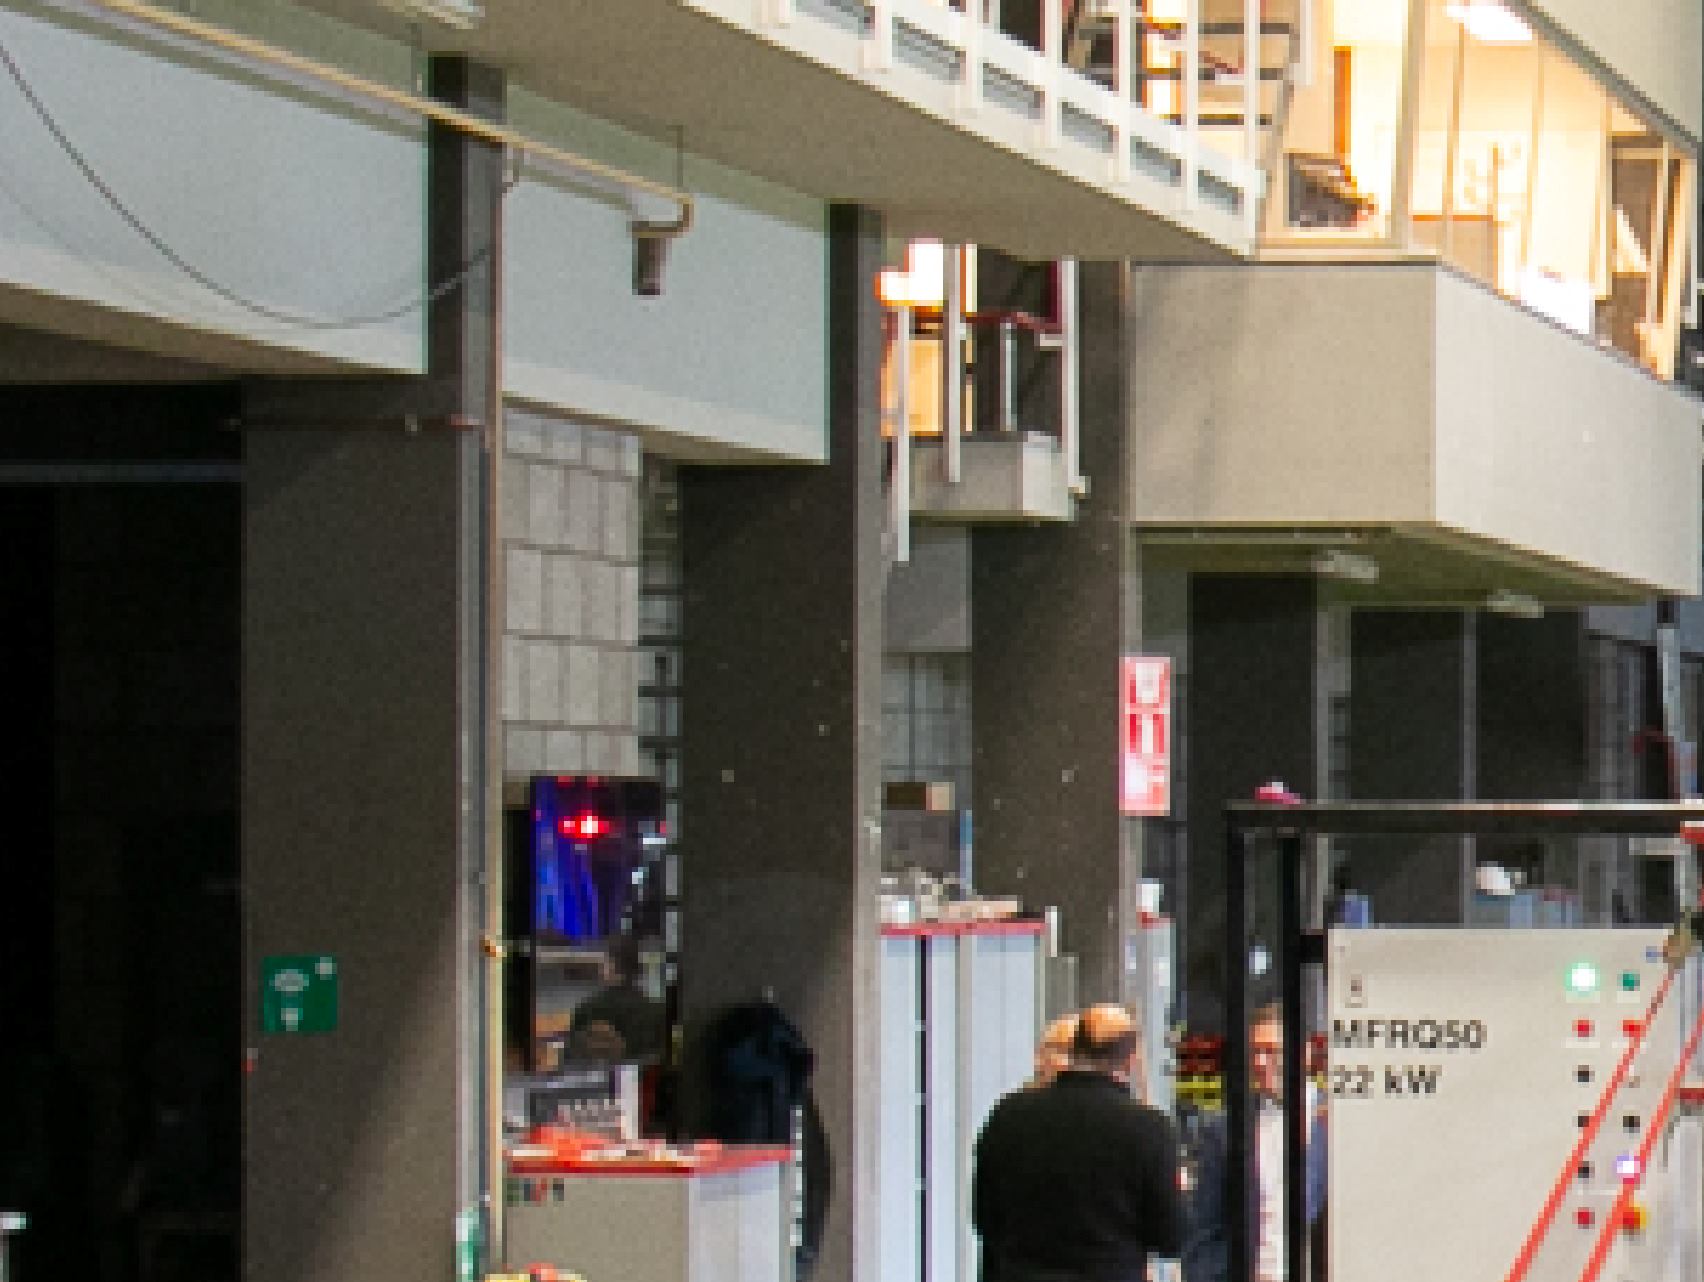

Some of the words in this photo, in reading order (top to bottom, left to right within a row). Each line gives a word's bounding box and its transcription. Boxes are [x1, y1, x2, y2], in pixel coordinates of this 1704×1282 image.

[1332, 1018, 1488, 1051] MFRQ50
[1332, 1065, 1375, 1098] 22
[1384, 1065, 1442, 1098] kW
